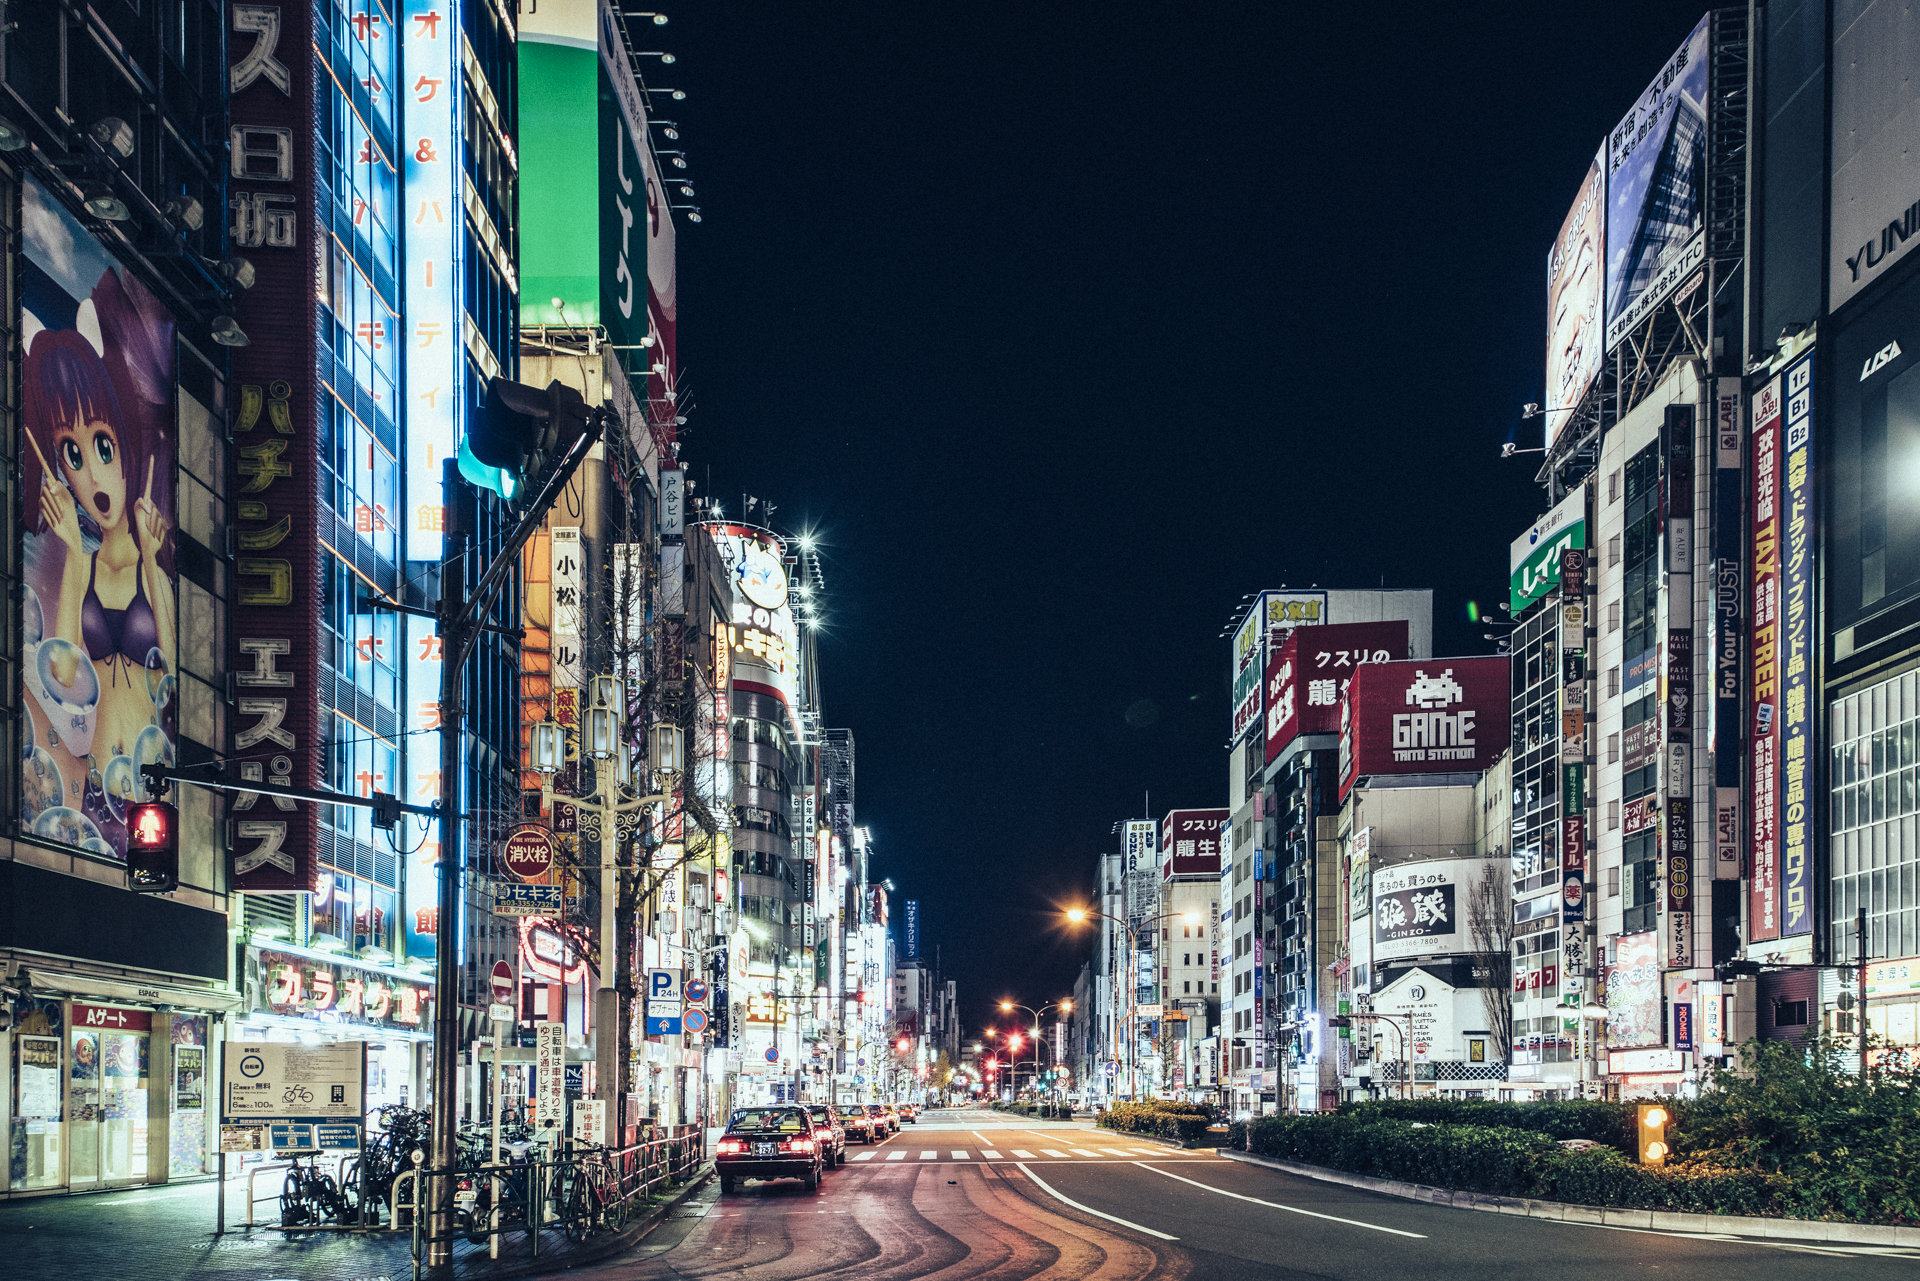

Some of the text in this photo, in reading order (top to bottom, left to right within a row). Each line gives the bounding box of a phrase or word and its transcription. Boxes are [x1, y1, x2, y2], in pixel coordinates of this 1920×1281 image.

[1566, 170, 1601, 253] GROUP
[1860, 339, 1902, 382] LISA
[1792, 371, 1807, 389] 1F
[1720, 396, 1733, 432] LABI
[1755, 398, 1778, 422] LABI
[1791, 397, 1807, 412] B1
[1790, 427, 1807, 446] B2
[233, 379, 296, 606] パチンコ
[1757, 427, 1774, 523] 欢迎光临
[664, 476, 680, 530] 戸谷ビル
[1755, 518, 1776, 584] TAX
[1718, 557, 1738, 618] JUST
[1755, 623, 1774, 703] FREE
[1719, 681, 1737, 699] For
[1392, 710, 1476, 749] GAME
[232, 637, 298, 876] エスパス
[1392, 748, 1476, 762] TAITO STATION
[1672, 759, 1681, 796] Rydia
[558, 818, 574, 829] 4F
[1623, 801, 1643, 820] まつげ
[1671, 801, 1688, 851] 飲み放題
[1719, 808, 1731, 844] LABI
[509, 845, 549, 863] 消火栓
[1129, 832, 1138, 871] SUNPARK
[1145, 831, 1154, 849] NEW
[1567, 819, 1581, 866] アイフル
[512, 884, 561, 902] セキネ
[1378, 872, 1447, 894] 売るのも 買うのも
[1565, 884, 1581, 900] 薬
[907, 910, 916, 957] オザキクリニック
[1564, 926, 1583, 974] 大勝軒
[138, 989, 160, 999] ESPACE
[652, 972, 672, 997] P
[660, 989, 679, 998] 24H
[86, 1008, 128, 1027] Aゲート
[649, 1002, 680, 1015] サブナード
[1678, 1005, 1688, 1041] PROMISE
[538, 1026, 550, 1118] ゆっくり通行しましょう
[550, 1026, 562, 1118] 自転車は車道寄りを
